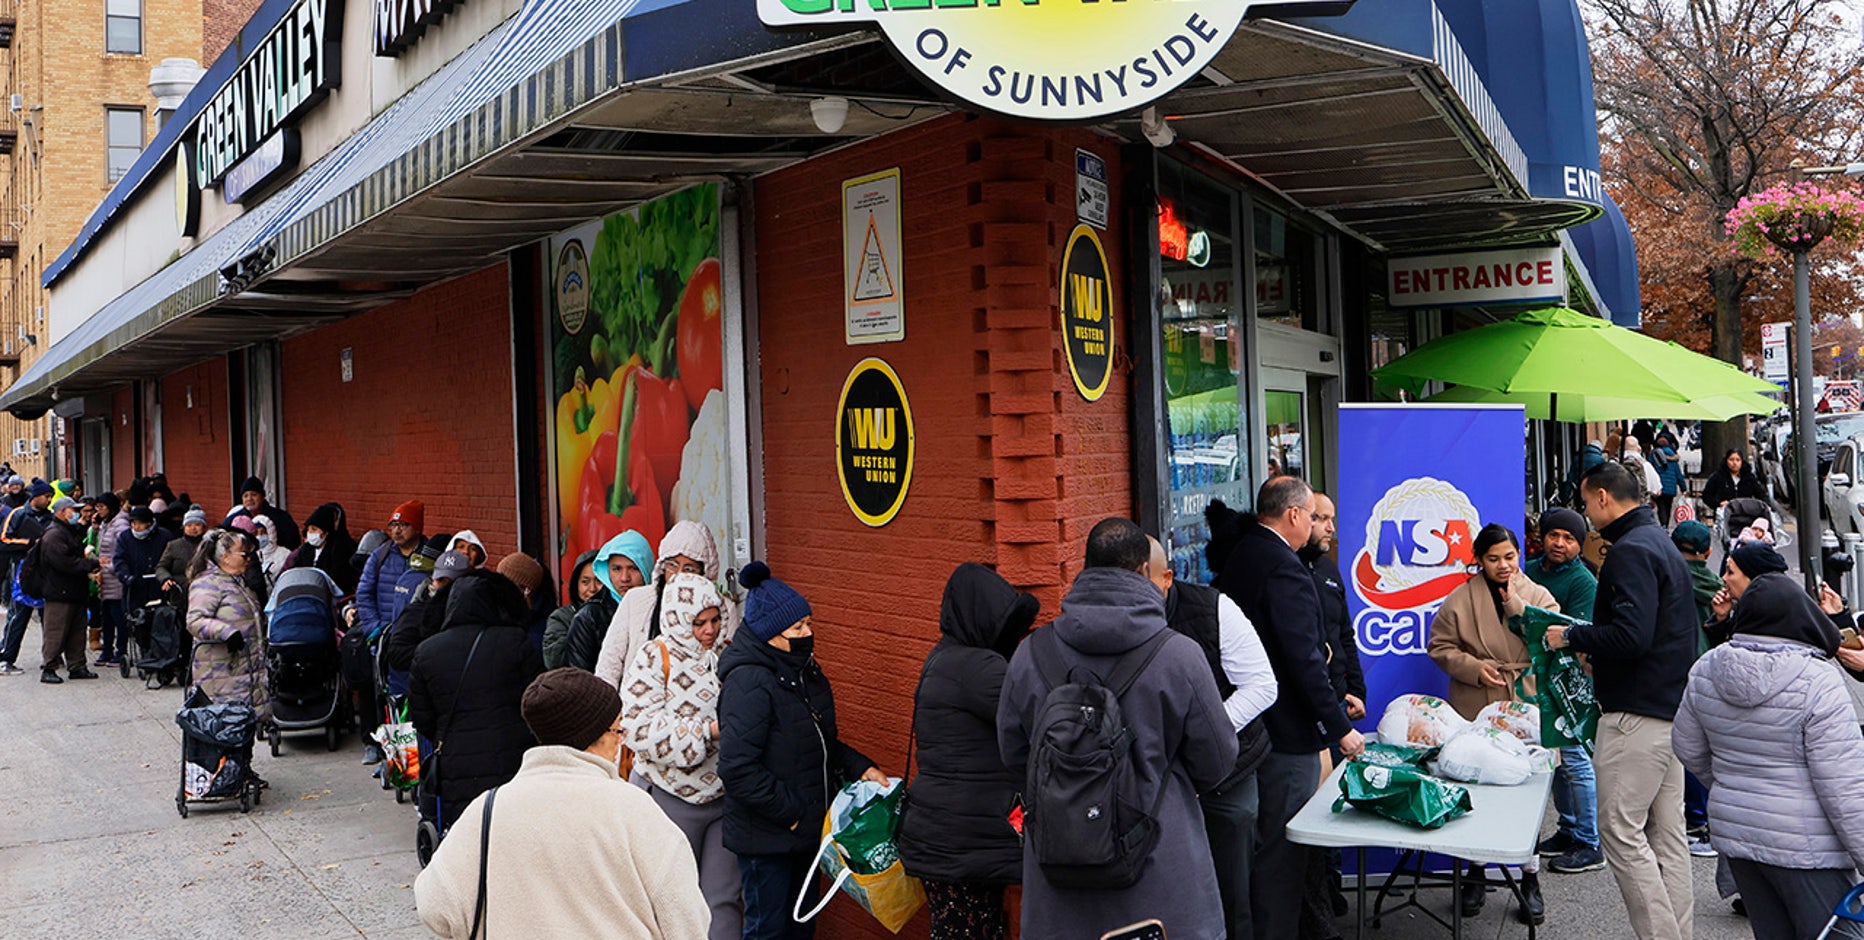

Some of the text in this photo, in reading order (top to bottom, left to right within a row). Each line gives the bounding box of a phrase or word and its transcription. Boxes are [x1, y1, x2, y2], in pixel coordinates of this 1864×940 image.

[916, 12, 1218, 106] OF SUNNYSIDE
[196, 68, 248, 190] GREEN
[250, 0, 327, 142] VALLEY
[1393, 261, 1554, 294] ENTRANCE
[1069, 272, 1103, 322] WU
[1074, 325, 1105, 341] WESTERN
[1084, 342, 1105, 356] UNION
[847, 407, 896, 451] WU
[853, 455, 897, 469] WESTERN
[866, 470, 896, 484] UNION
[1376, 519, 1475, 566] NSA
